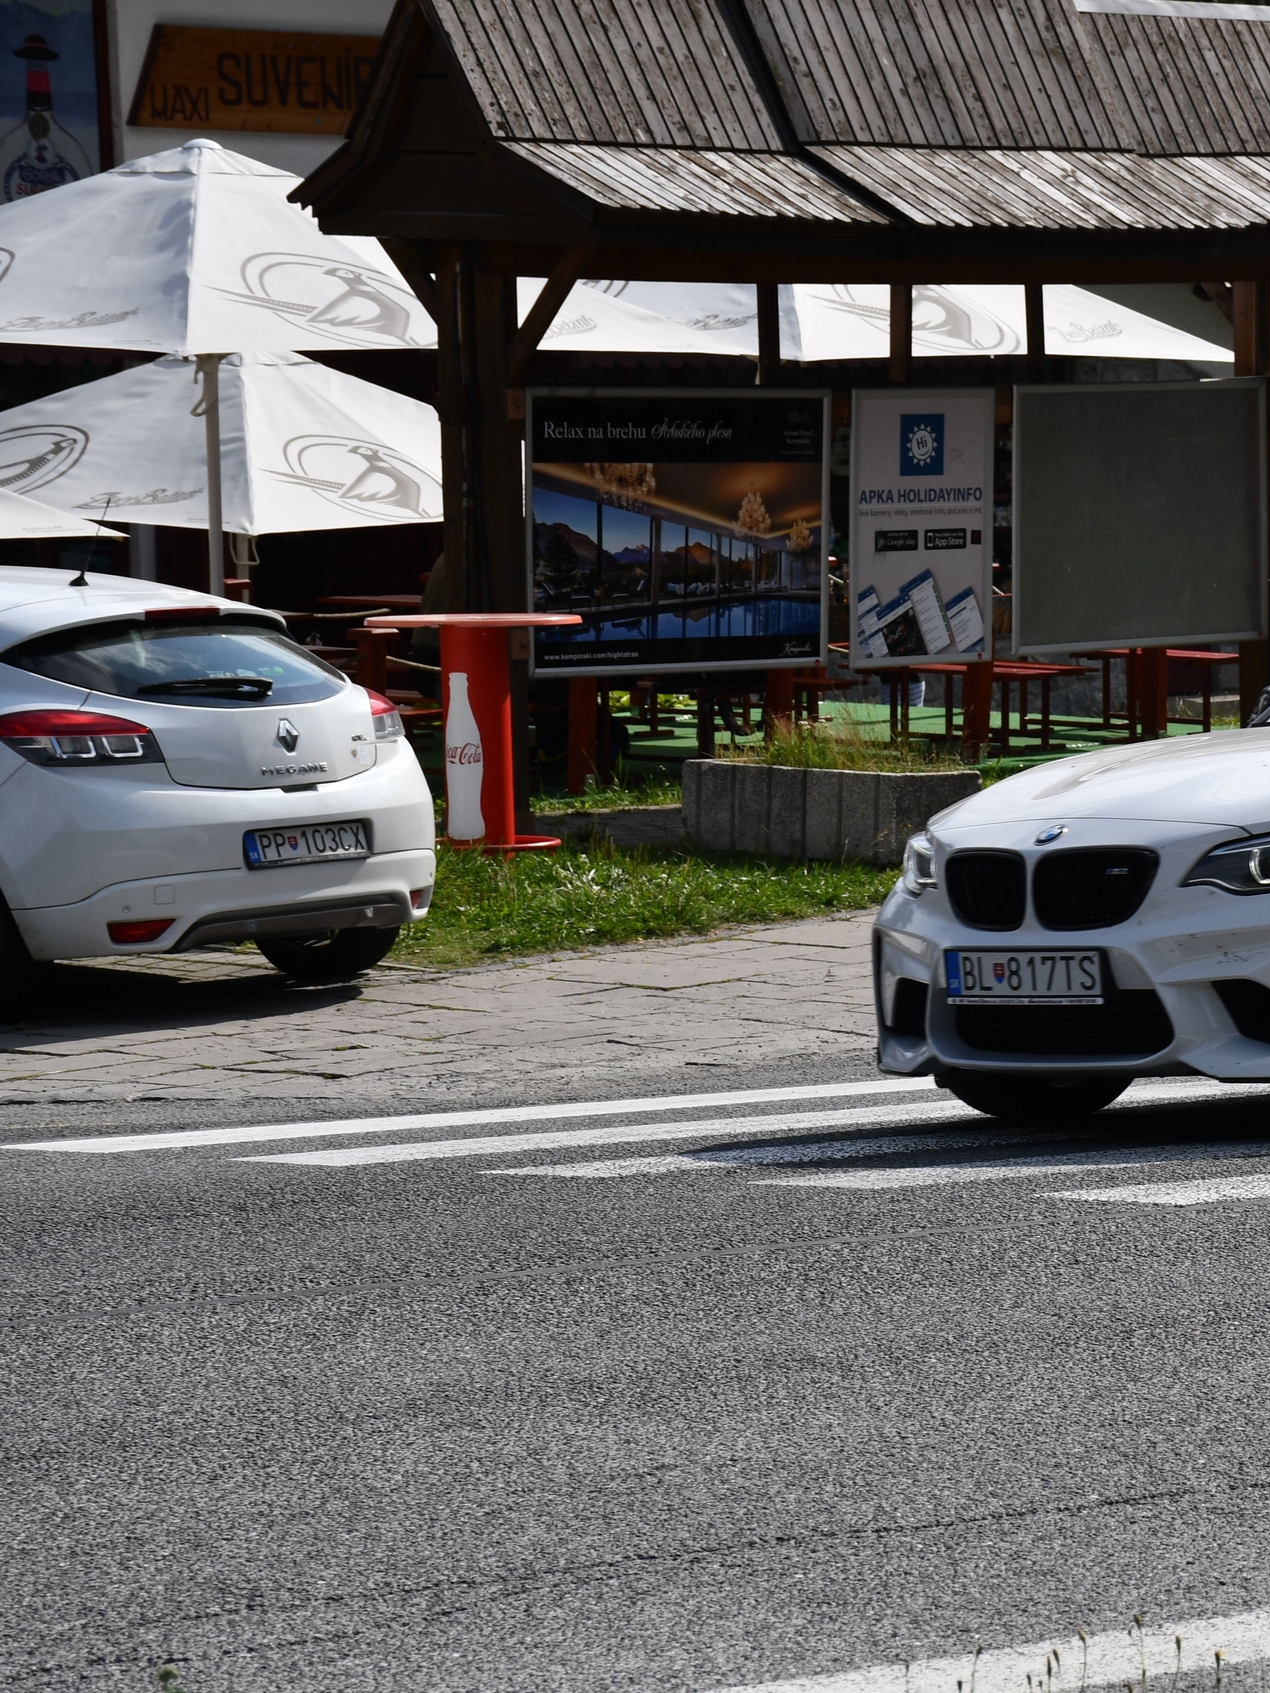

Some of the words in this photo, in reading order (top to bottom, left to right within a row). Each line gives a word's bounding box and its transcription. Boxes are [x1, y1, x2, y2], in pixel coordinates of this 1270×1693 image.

[150, 84, 210, 121] MAXI
[543, 421, 584, 439] Relax
[588, 427, 603, 439] na
[607, 422, 646, 439] brehu
[651, 418, 705, 439] Štrbského
[706, 421, 732, 444] plesa
[916, 436, 928, 450] Hi
[859, 489, 894, 504] APKA
[898, 487, 982, 503] HOLIDAYINFO
[935, 538, 947, 547] App
[948, 537, 964, 545] Store
[544, 651, 638, 661] www.kempinski.com/hightatras
[260, 762, 329, 776] MEGANE
[258, 832, 286, 859] PP
[301, 826, 365, 854] 103CX
[249, 851, 259, 860] SK
[962, 956, 993, 991] BL
[1007, 956, 1097, 991] 817TS
